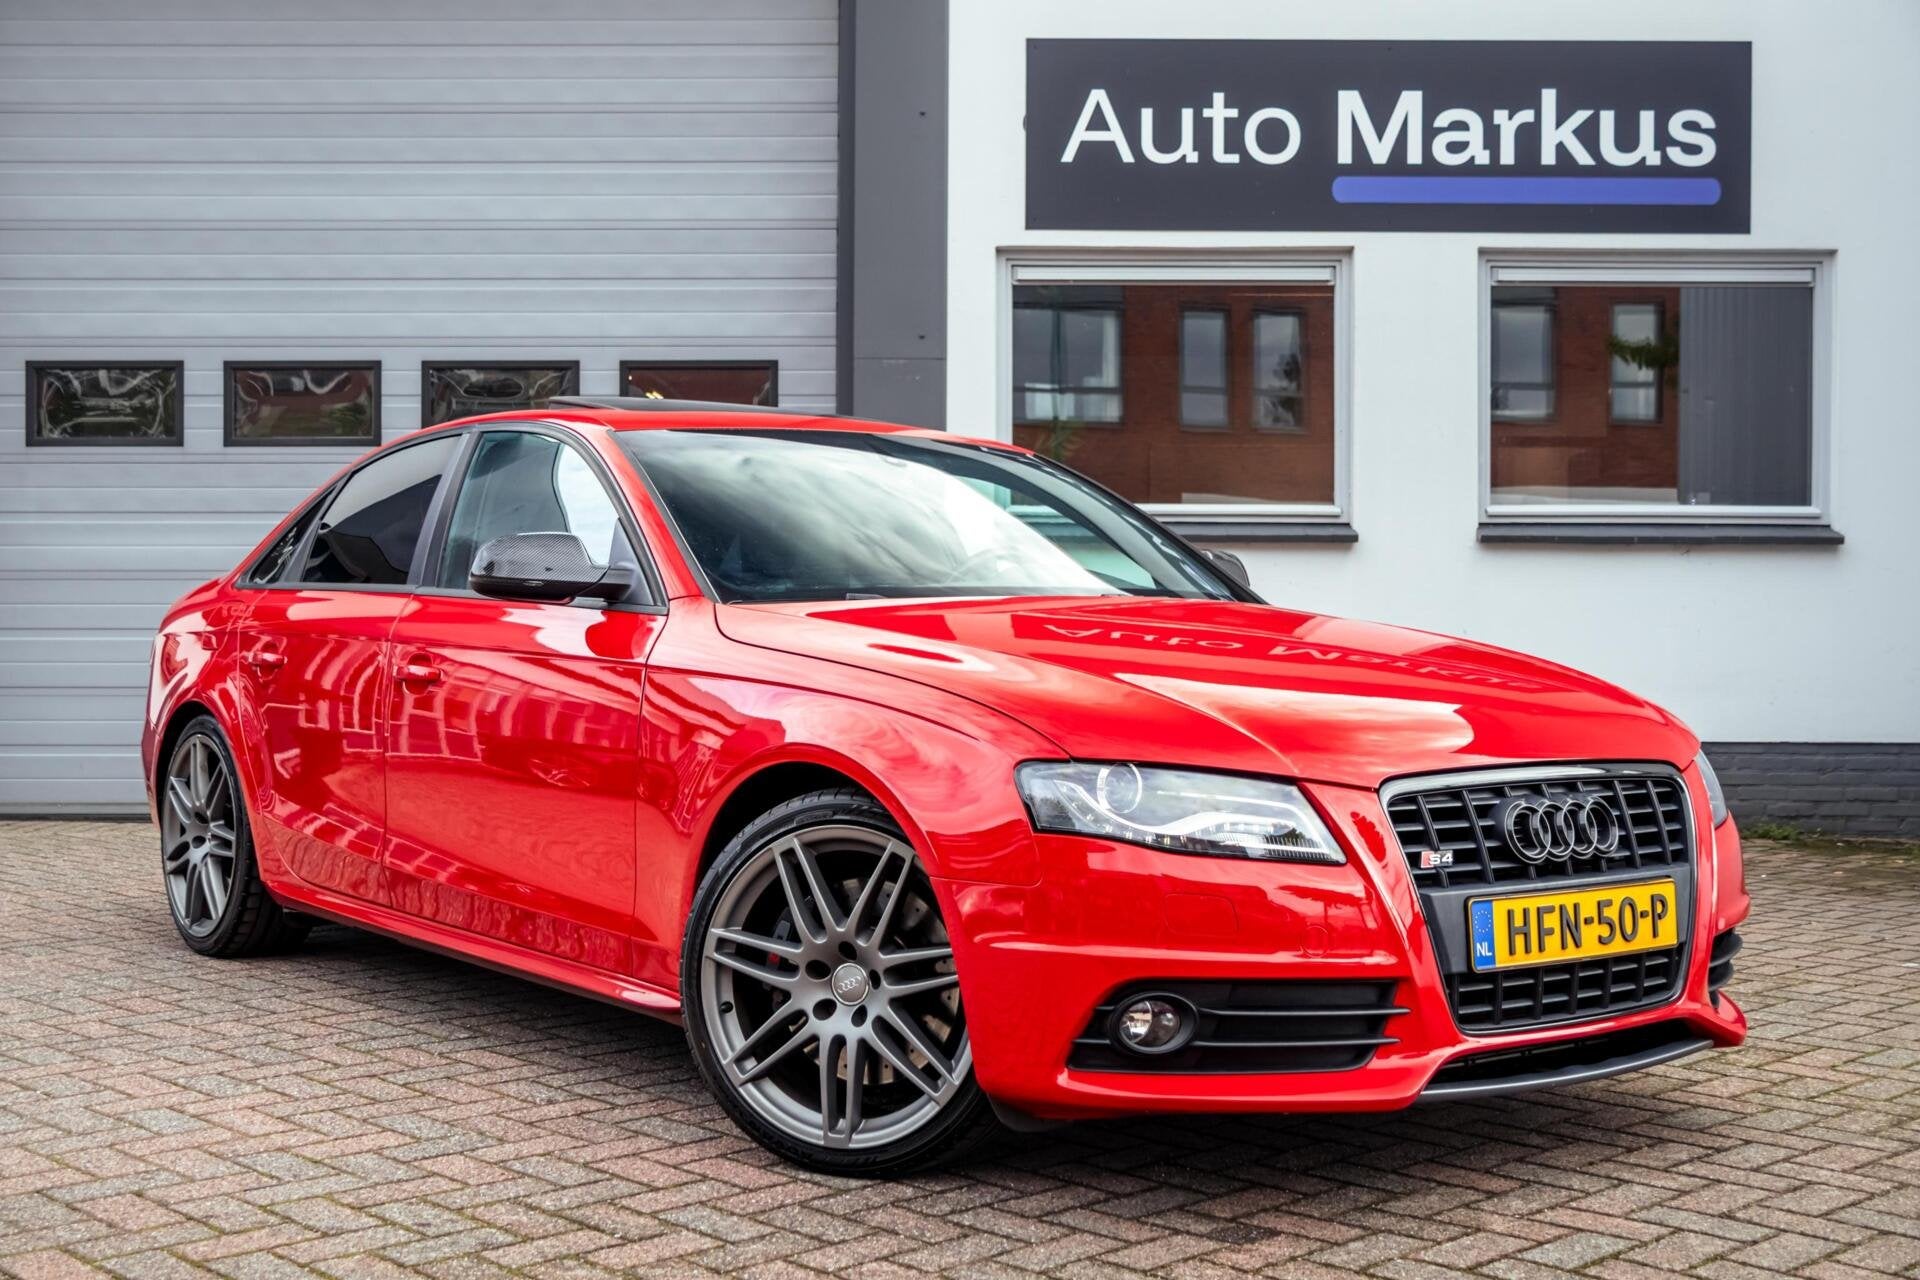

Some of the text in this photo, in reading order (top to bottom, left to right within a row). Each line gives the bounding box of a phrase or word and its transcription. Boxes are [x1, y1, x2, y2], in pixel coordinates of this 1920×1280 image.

[1060, 87, 1718, 168] Auto Markus
[1476, 941, 1493, 957] NL
[1506, 892, 1669, 957] HFN-50-P
